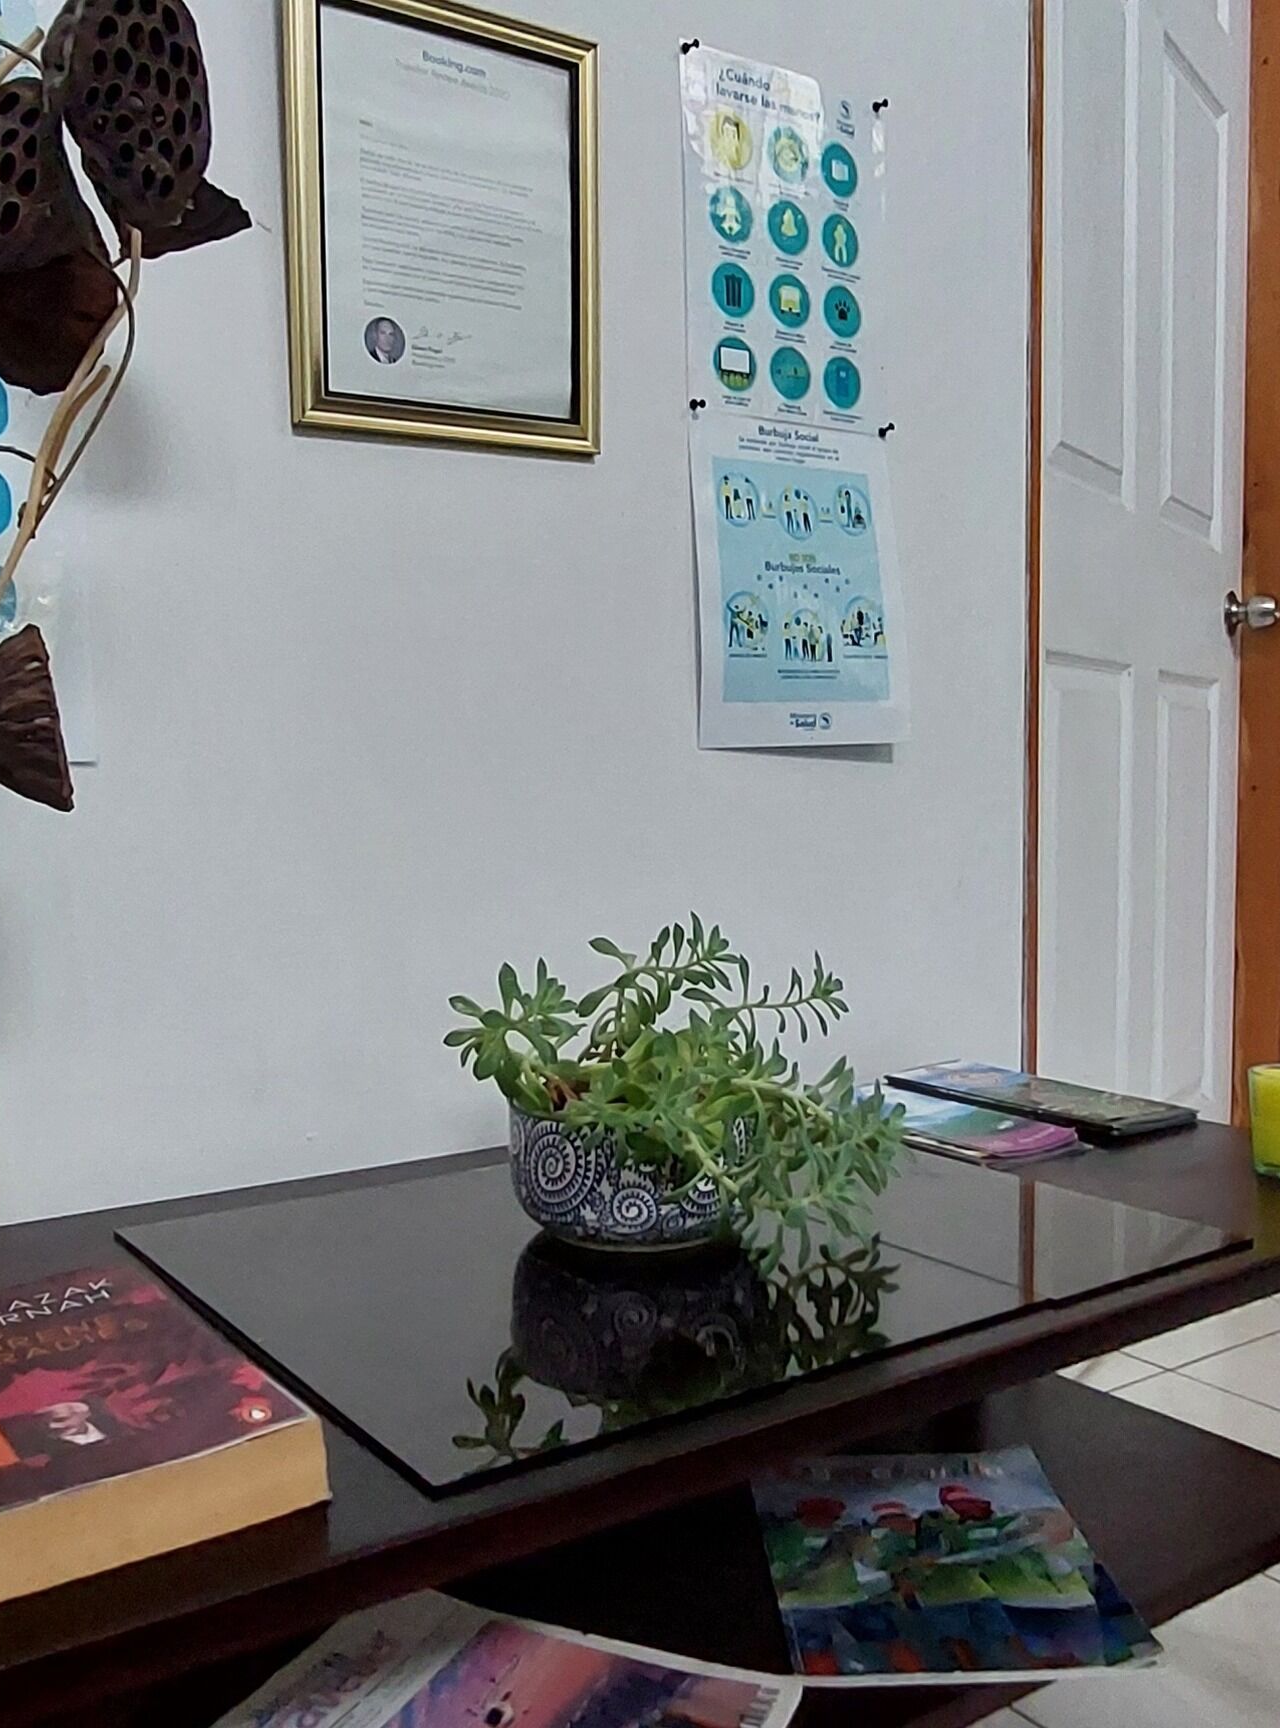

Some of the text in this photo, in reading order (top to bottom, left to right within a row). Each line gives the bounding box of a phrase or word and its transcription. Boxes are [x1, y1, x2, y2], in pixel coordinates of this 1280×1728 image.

[422, 49, 487, 78] Booking.com
[794, 430, 819, 442] Social
[806, 563, 840, 576] Sociales
